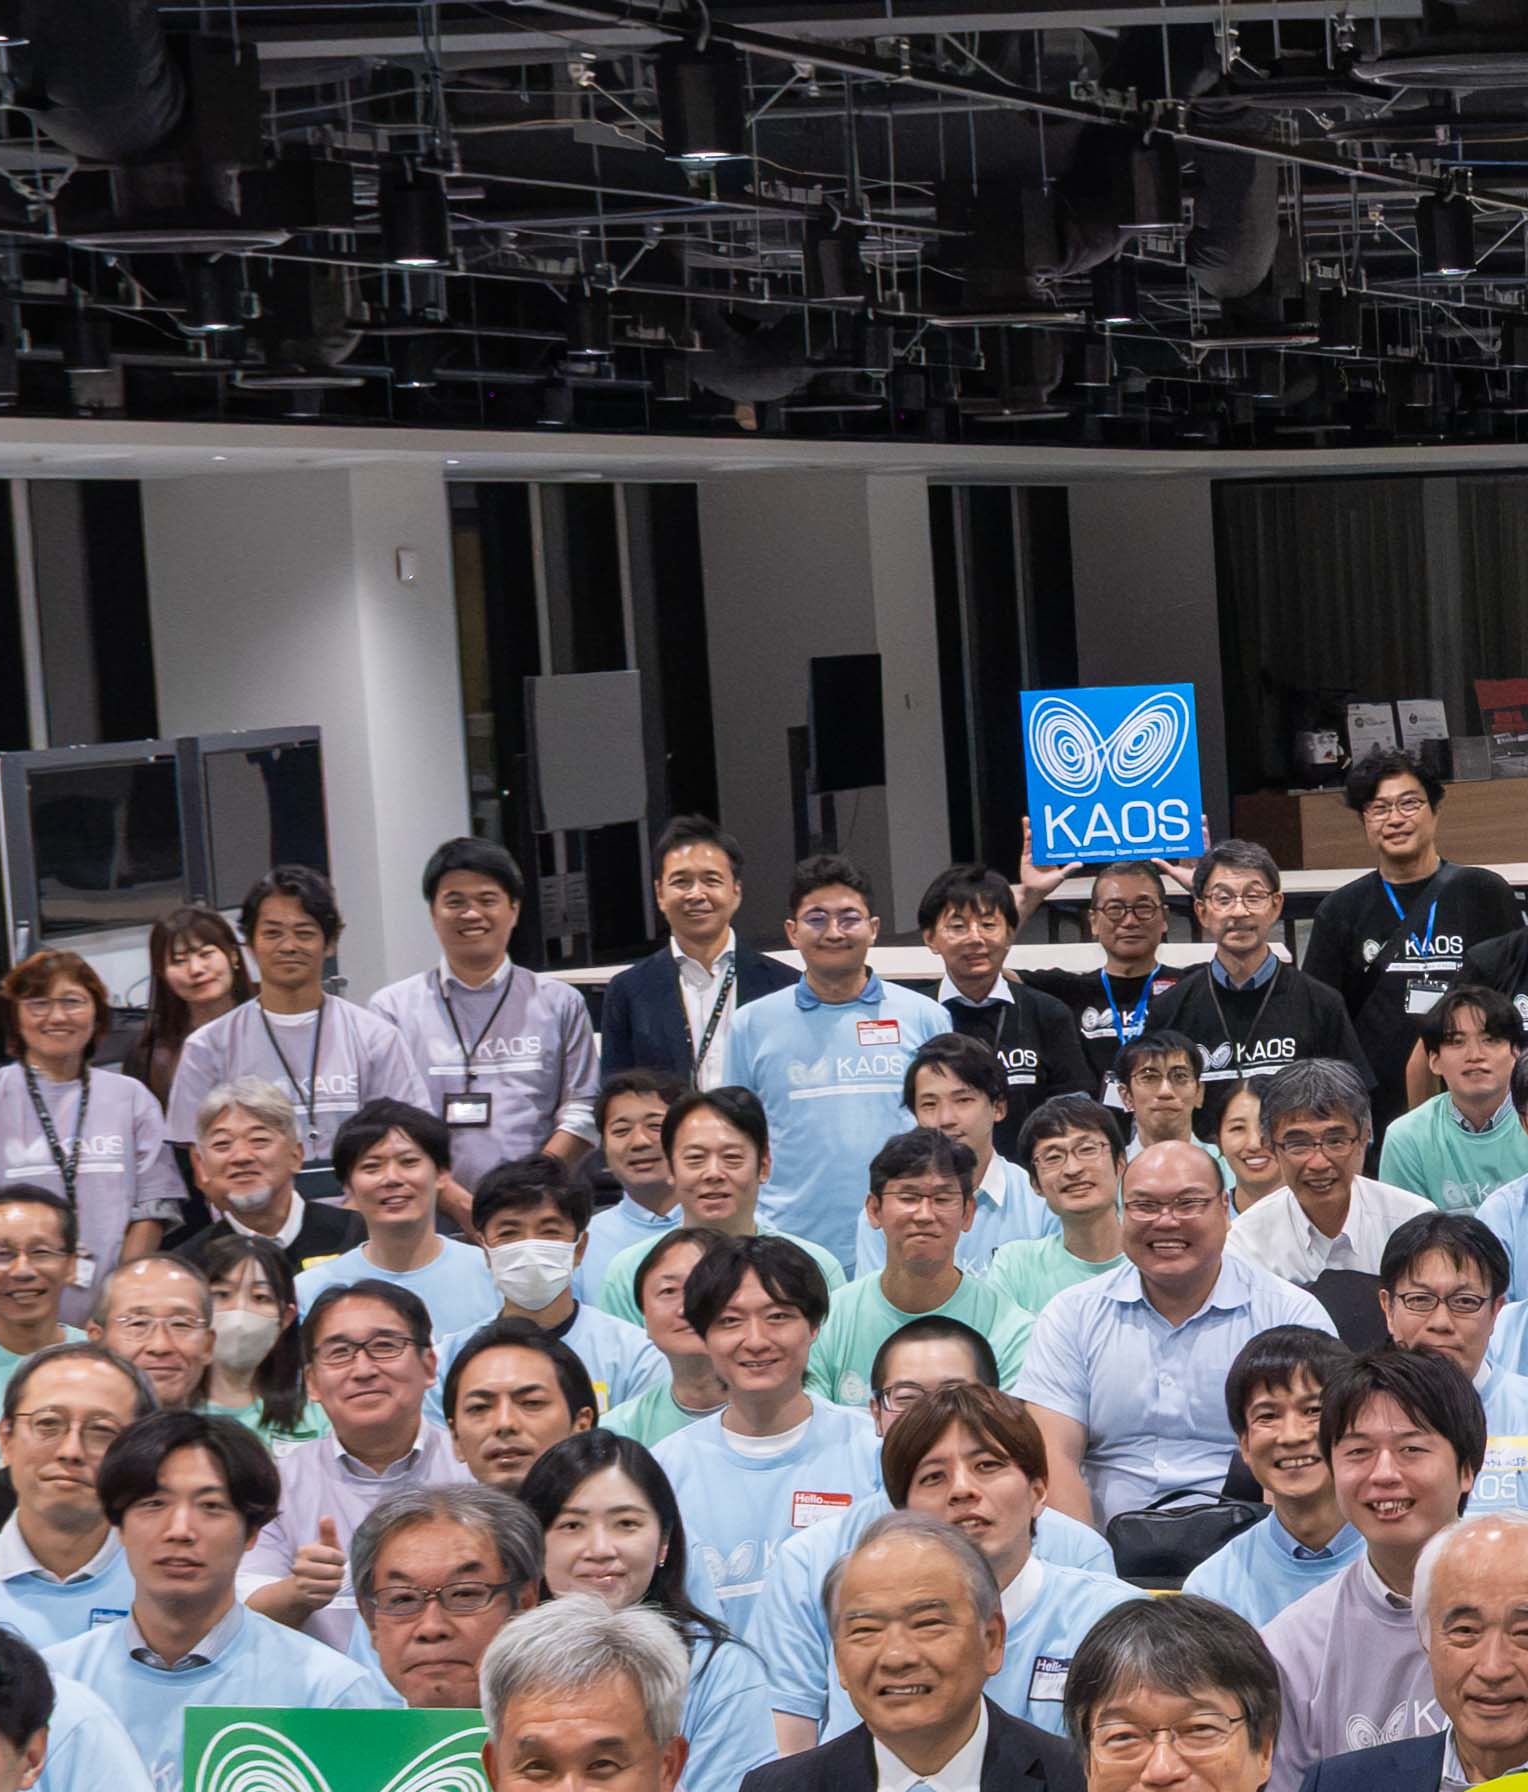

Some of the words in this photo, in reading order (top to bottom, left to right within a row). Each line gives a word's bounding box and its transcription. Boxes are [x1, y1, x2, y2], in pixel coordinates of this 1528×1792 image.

[1044, 799, 1190, 849] KAOS
[1405, 935, 1463, 956] KAOS
[478, 1036, 541, 1058] KAOS
[1236, 1038, 1296, 1062] KAOS
[836, 1056, 904, 1078] KAOS
[300, 1074, 359, 1094] KAOS
